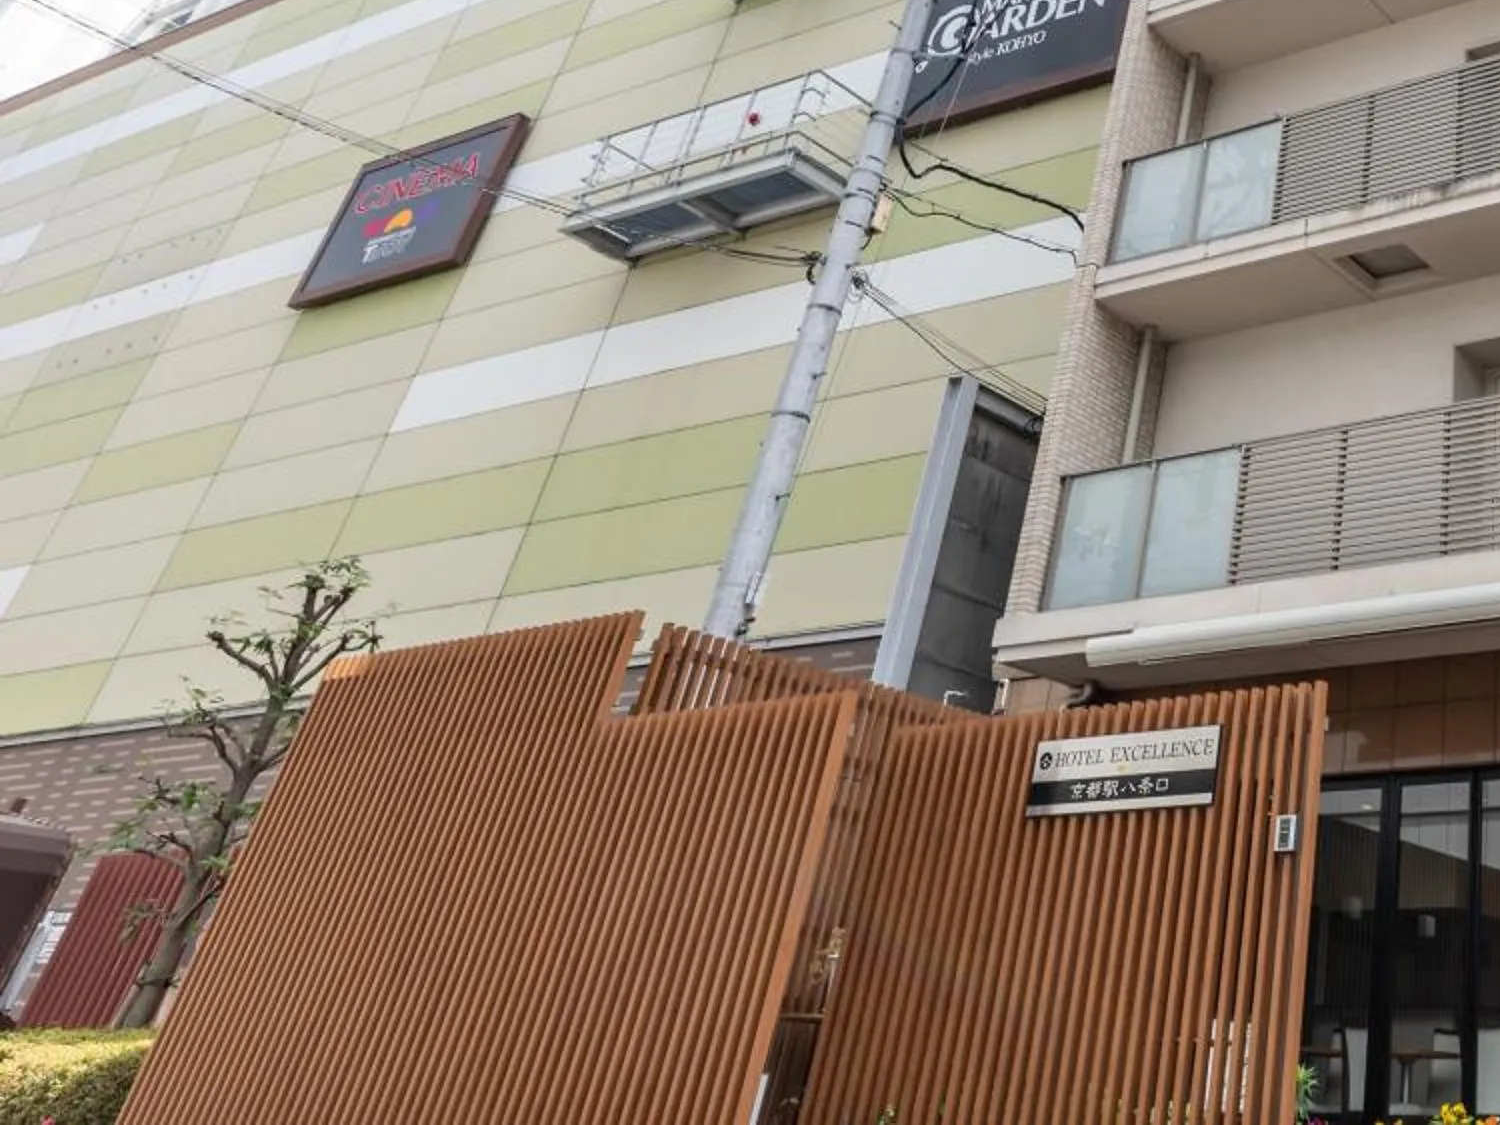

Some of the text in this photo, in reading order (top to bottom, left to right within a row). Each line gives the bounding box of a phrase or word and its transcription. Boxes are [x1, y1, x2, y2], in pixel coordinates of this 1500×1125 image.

[1055, 738, 1215, 768] HOTEL EXCELLENCE
[1071, 776, 1169, 800] 京都駅八条口
